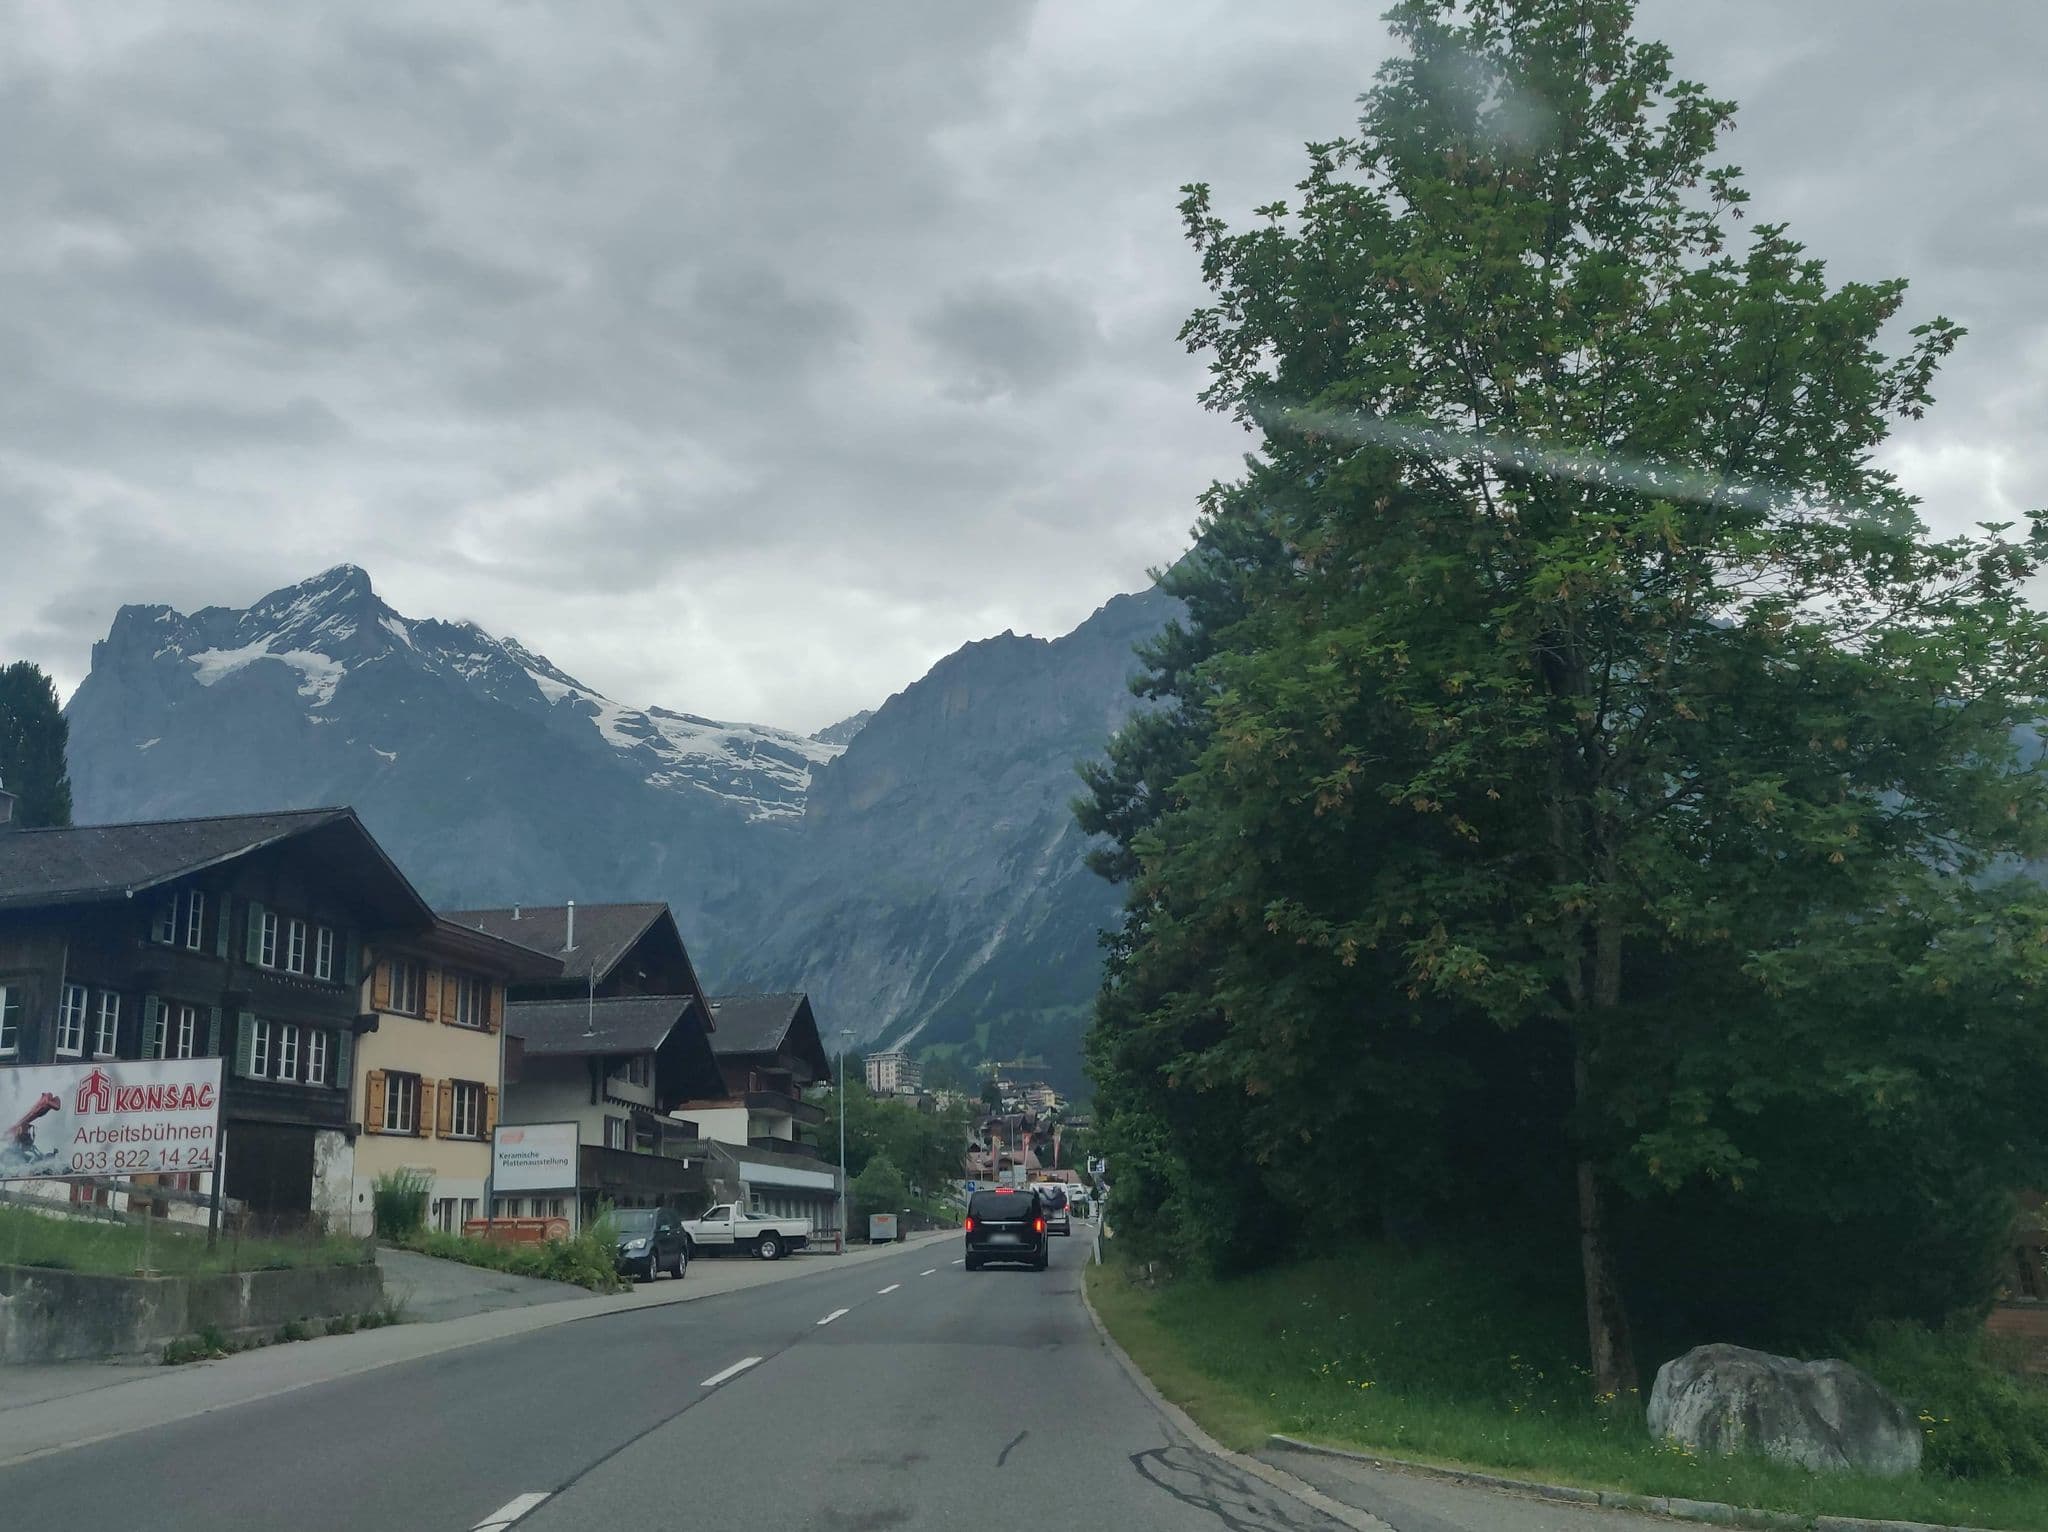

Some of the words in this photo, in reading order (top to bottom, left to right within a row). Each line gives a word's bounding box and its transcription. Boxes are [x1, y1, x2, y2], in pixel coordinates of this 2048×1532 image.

[74, 1123, 213, 1144] Arbeitsbühnen
[72, 1151, 107, 1170] 033
[115, 1149, 149, 1168] 822
[159, 1147, 180, 1165] 14
[187, 1146, 210, 1165] 24
[499, 1152, 539, 1160] Keramische
[503, 1158, 569, 1167] Plattenausstellung
